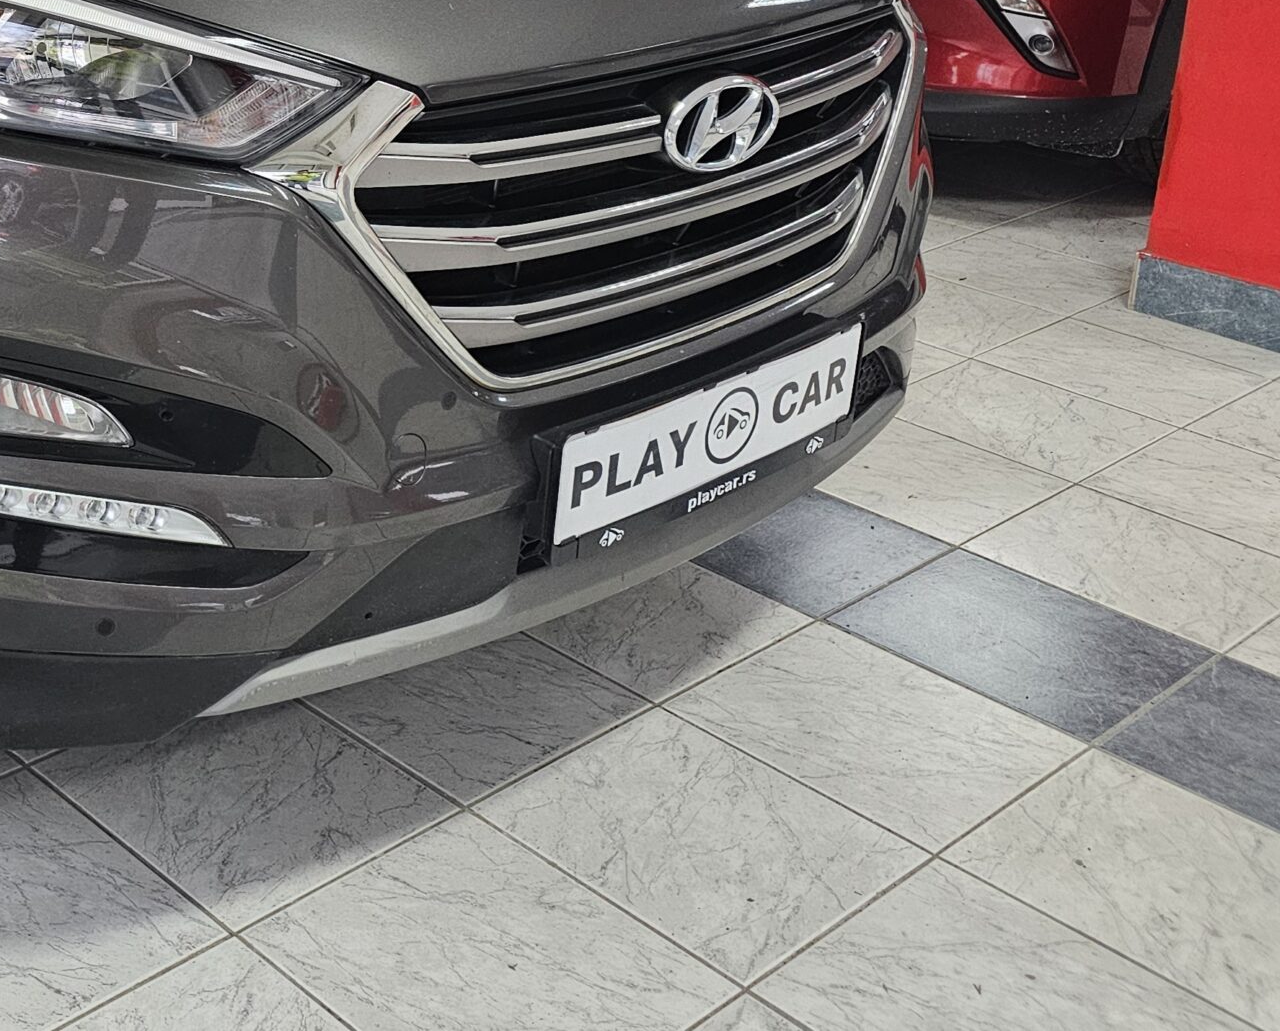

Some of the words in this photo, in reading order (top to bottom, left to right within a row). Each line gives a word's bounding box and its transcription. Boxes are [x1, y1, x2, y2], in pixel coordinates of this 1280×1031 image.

[570, 421, 698, 510] PLAY
[772, 357, 847, 424] CAR
[687, 469, 757, 513] playcar.rs
